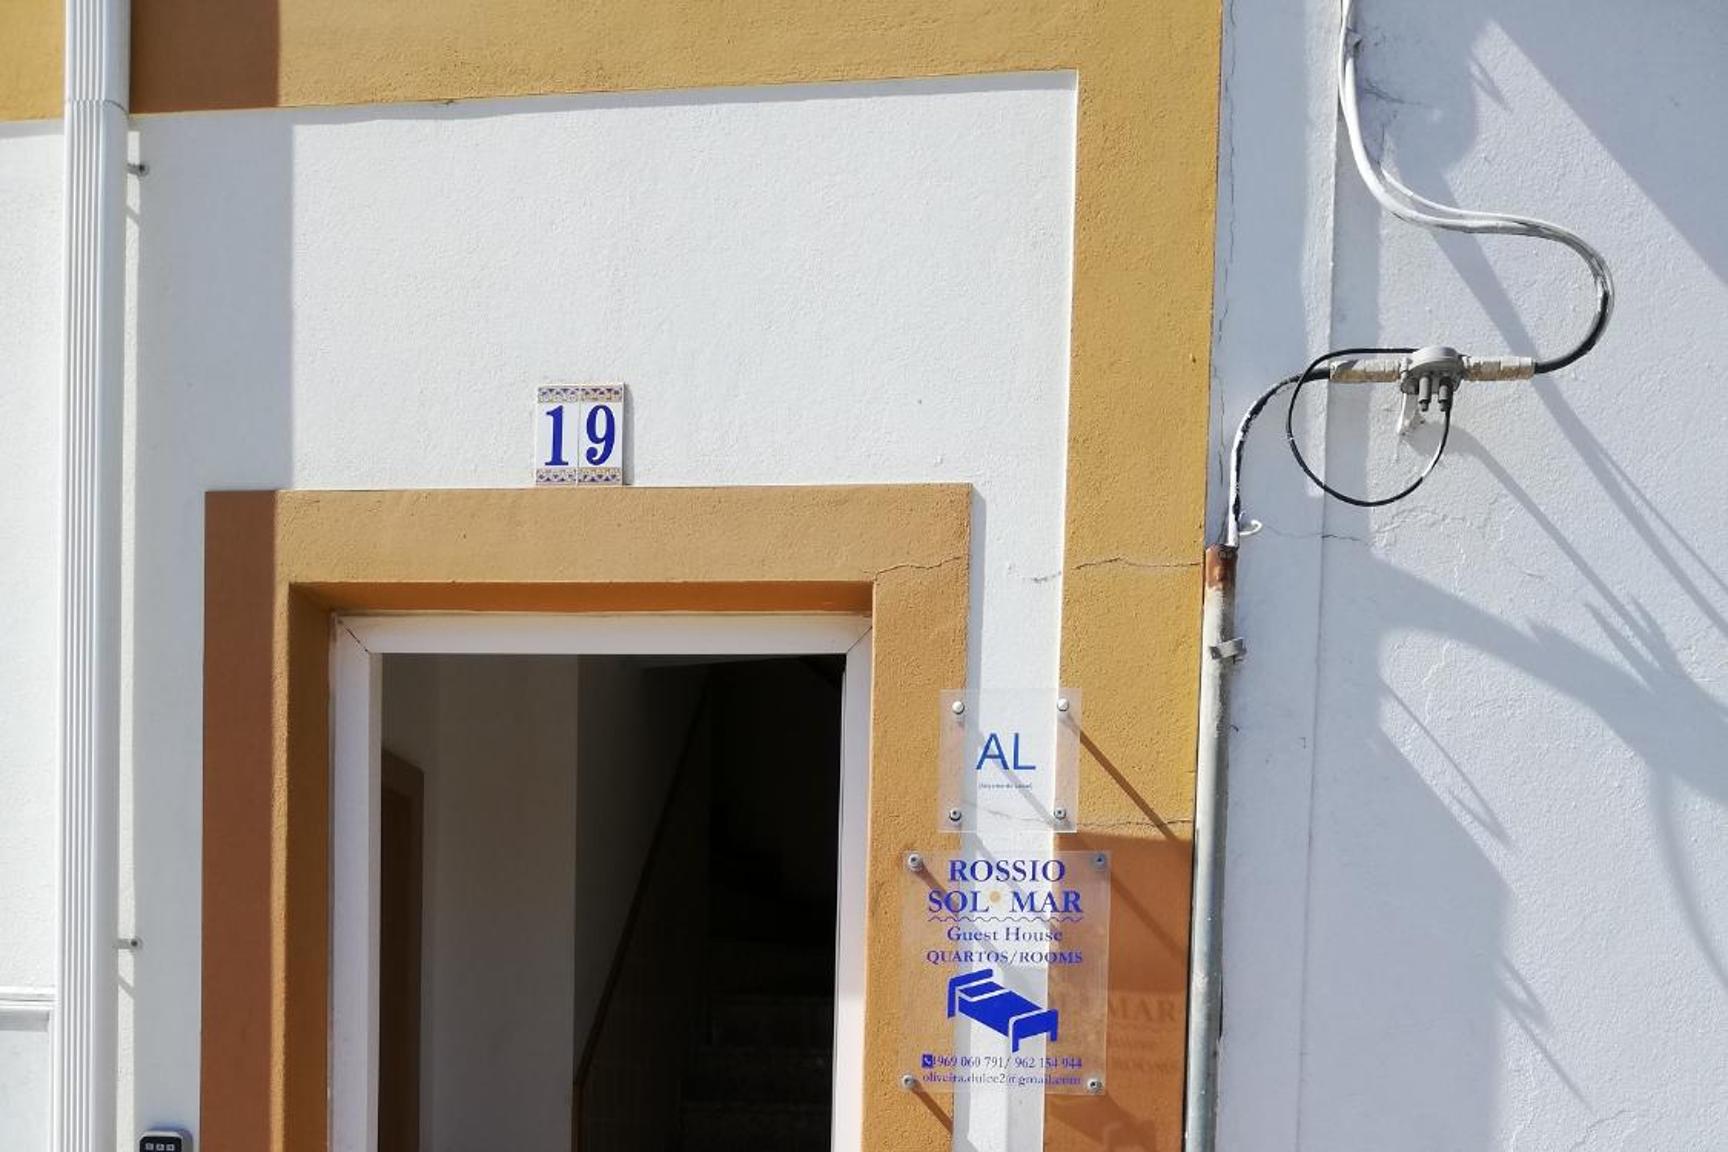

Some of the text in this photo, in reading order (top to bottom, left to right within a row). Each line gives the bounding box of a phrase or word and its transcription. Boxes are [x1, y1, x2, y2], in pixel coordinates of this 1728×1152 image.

[544, 404, 616, 466] 19
[976, 732, 1036, 770] AL
[948, 859, 1066, 882] ROSSIO
[928, 890, 1083, 913] SOL MAR
[947, 925, 1063, 941] Guest House
[926, 950, 1083, 964] QUARTOS/ROOMS
